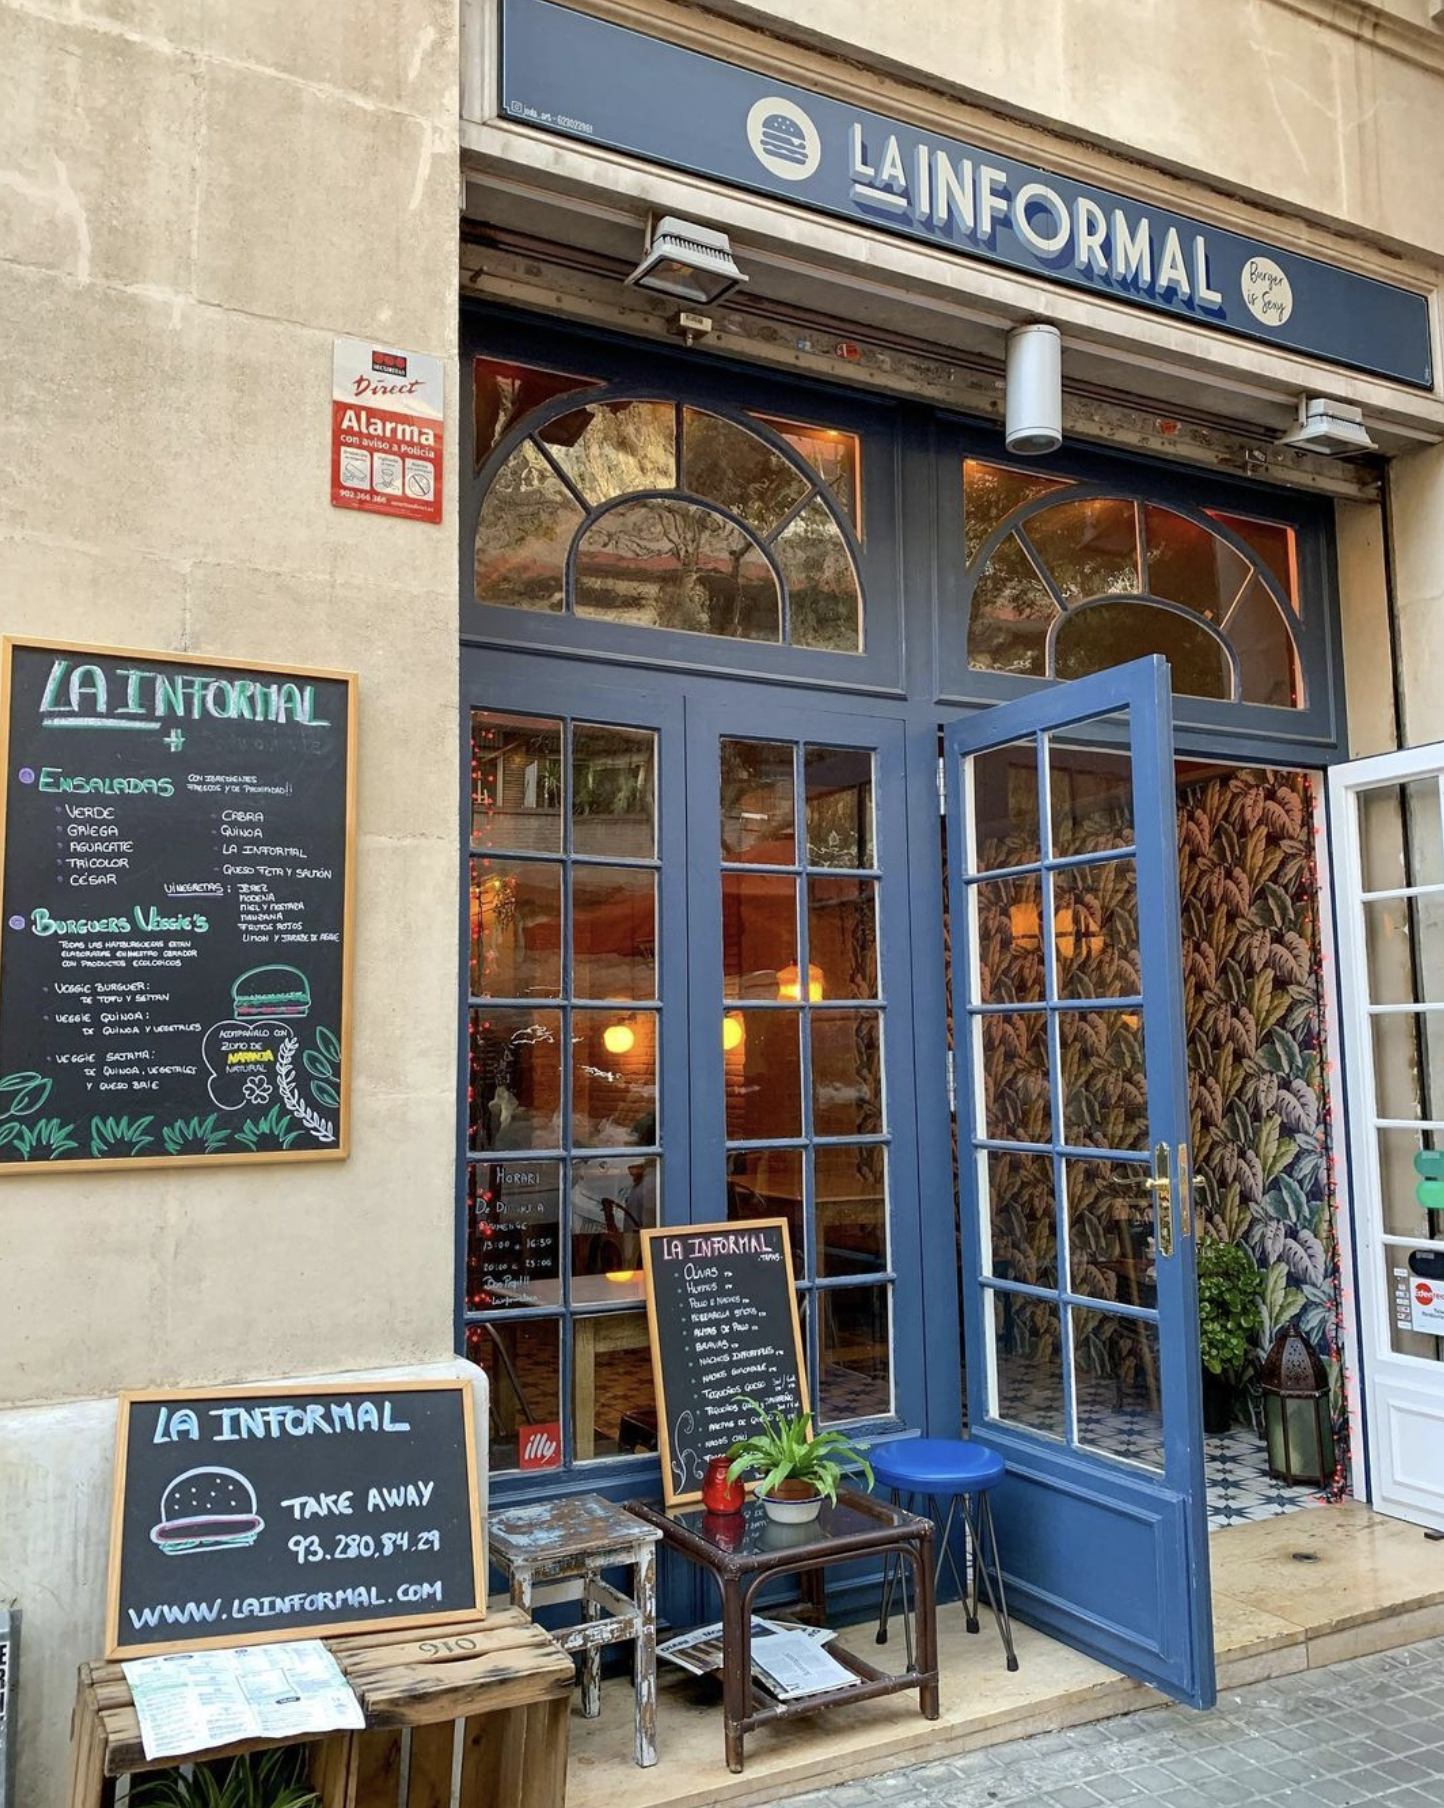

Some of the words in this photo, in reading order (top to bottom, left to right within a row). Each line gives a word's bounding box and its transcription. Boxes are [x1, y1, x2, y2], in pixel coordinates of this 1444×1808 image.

[850, 122, 907, 190] LA
[913, 143, 1224, 310] INFORMAL
[1250, 261, 1284, 291] Burger
[1248, 289, 1258, 306] is
[1262, 291, 1286, 323] Sexy
[353, 375, 426, 397] Direct
[341, 409, 435, 446] Alarma
[340, 434, 360, 445] con
[362, 437, 390, 450] aviso
[391, 443, 398, 452] a
[39, 660, 107, 714] LA
[114, 669, 331, 727] INFORMAL
[38, 767, 175, 796] ENSALADAS
[65, 803, 115, 820] VERDE
[221, 810, 264, 823] CABRA
[67, 823, 118, 837] GRIEGA
[220, 824, 263, 838] QUINOA
[70, 840, 134, 853] AGUACATE
[222, 844, 237, 854] LA
[241, 845, 307, 858] INFORMAL
[65, 857, 129, 870] TRICOLOR
[222, 863, 255, 876] QUESO
[256, 866, 284, 878] FETA
[285, 868, 292, 878] Y
[239, 892, 276, 902] MODENA
[262, 903, 268, 911] Y
[31, 908, 131, 937] BURGUERS
[275, 921, 303, 931] ROJOS
[274, 934, 280, 942] Y
[62, 960, 77, 968] CON
[54, 983, 91, 994] VEGGIE
[80, 996, 93, 1004] DE
[97, 995, 123, 1004] TOFU
[135, 993, 170, 1002] SEITAN
[55, 1013, 92, 1023] VEGGIE
[82, 1027, 94, 1036] DE
[102, 1026, 140, 1035] QUINOA
[145, 1025, 152, 1034] Y
[273, 1029, 288, 1037] CON
[55, 1053, 96, 1063] VEGGIE
[84, 1068, 96, 1076] DE
[226, 1063, 267, 1074] NATURAL
[86, 1082, 93, 1091] Y
[99, 1082, 129, 1090] QUESO
[496, 1166, 540, 1185] HORARI
[664, 1238, 683, 1260] LA
[688, 1233, 773, 1257] INFORMAL
[684, 1263, 718, 1280] OLIVAS
[689, 1297, 708, 1308] POLLO
[721, 1325, 730, 1334] DE
[695, 1339, 729, 1352] BRAVAS
[699, 1353, 730, 1366] NACHOS
[153, 1407, 199, 1444] LA
[209, 1401, 411, 1441] INFORMAL
[524, 1433, 557, 1464] illy
[281, 1490, 354, 1520] TAKE
[367, 1481, 434, 1512] AWAY
[287, 1530, 440, 1564] 93.280.84.29
